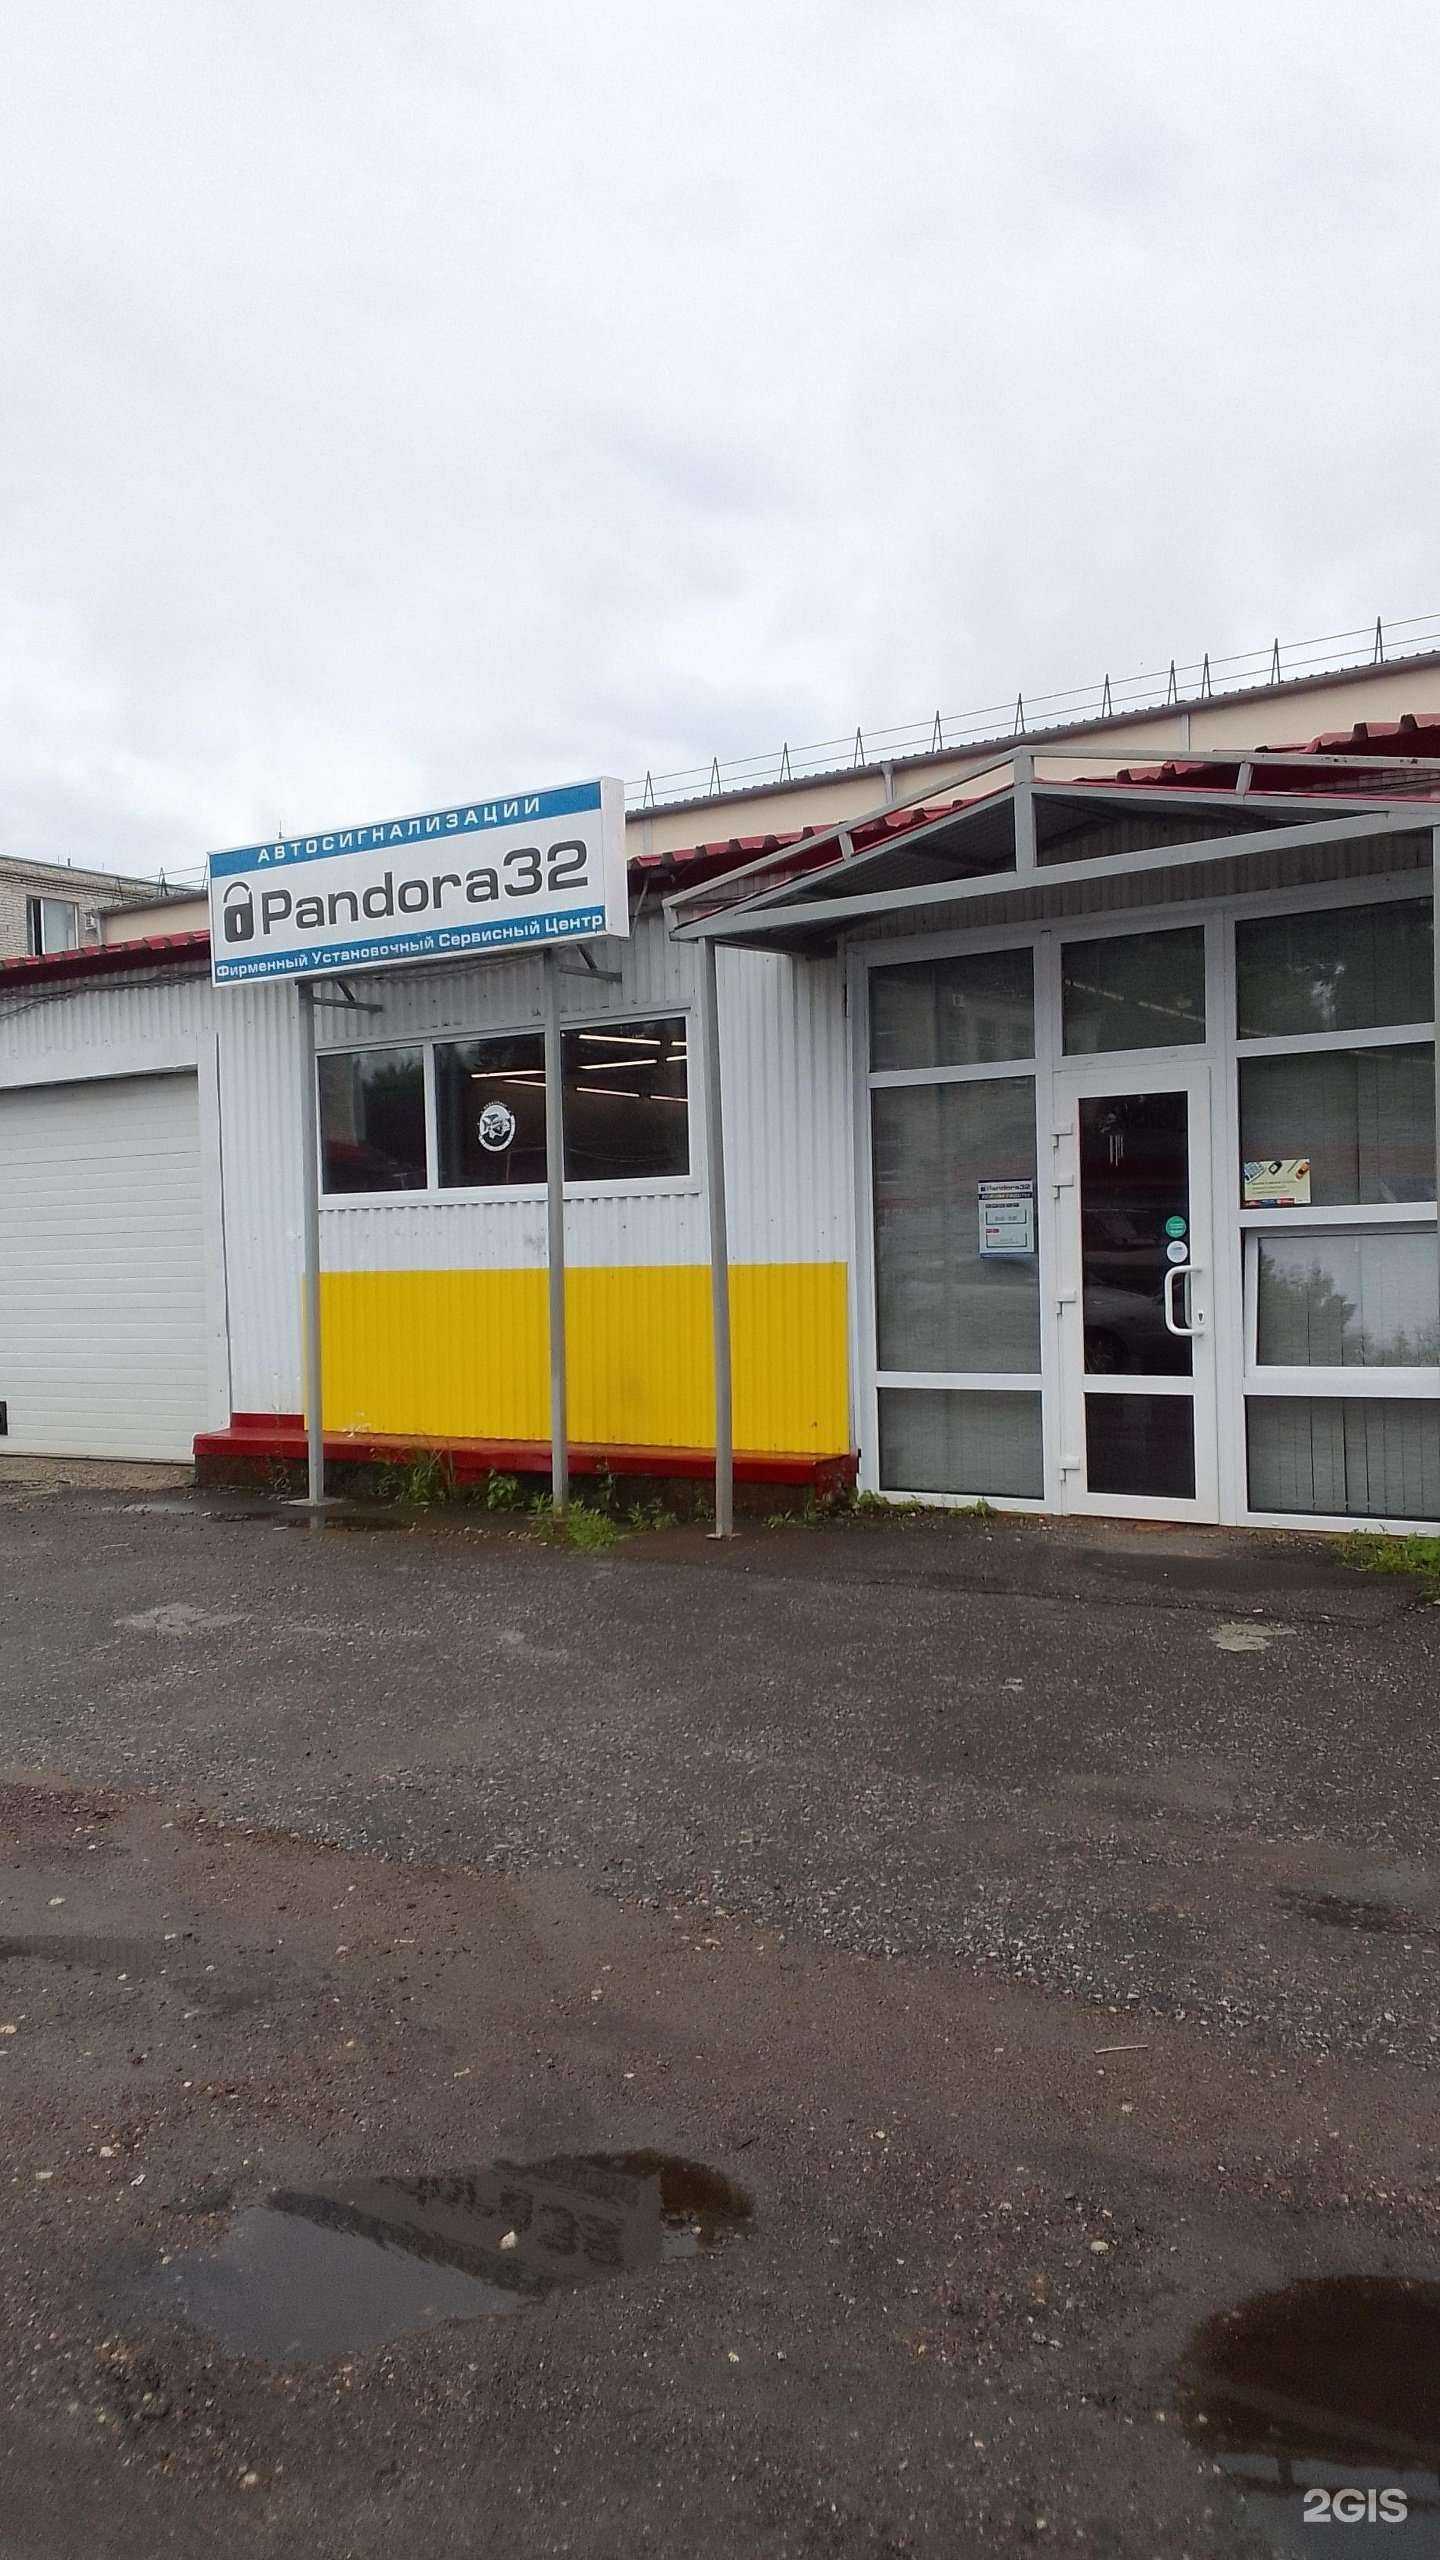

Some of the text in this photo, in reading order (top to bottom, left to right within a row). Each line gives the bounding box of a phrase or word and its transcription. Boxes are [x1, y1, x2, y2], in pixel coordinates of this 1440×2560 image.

[257, 797, 541, 864] АВТОСИГНАЛИЗАЦИИ
[262, 839, 589, 935] Pandora32
[216, 913, 603, 979] Фирменный Установочный Сервисный Центр
